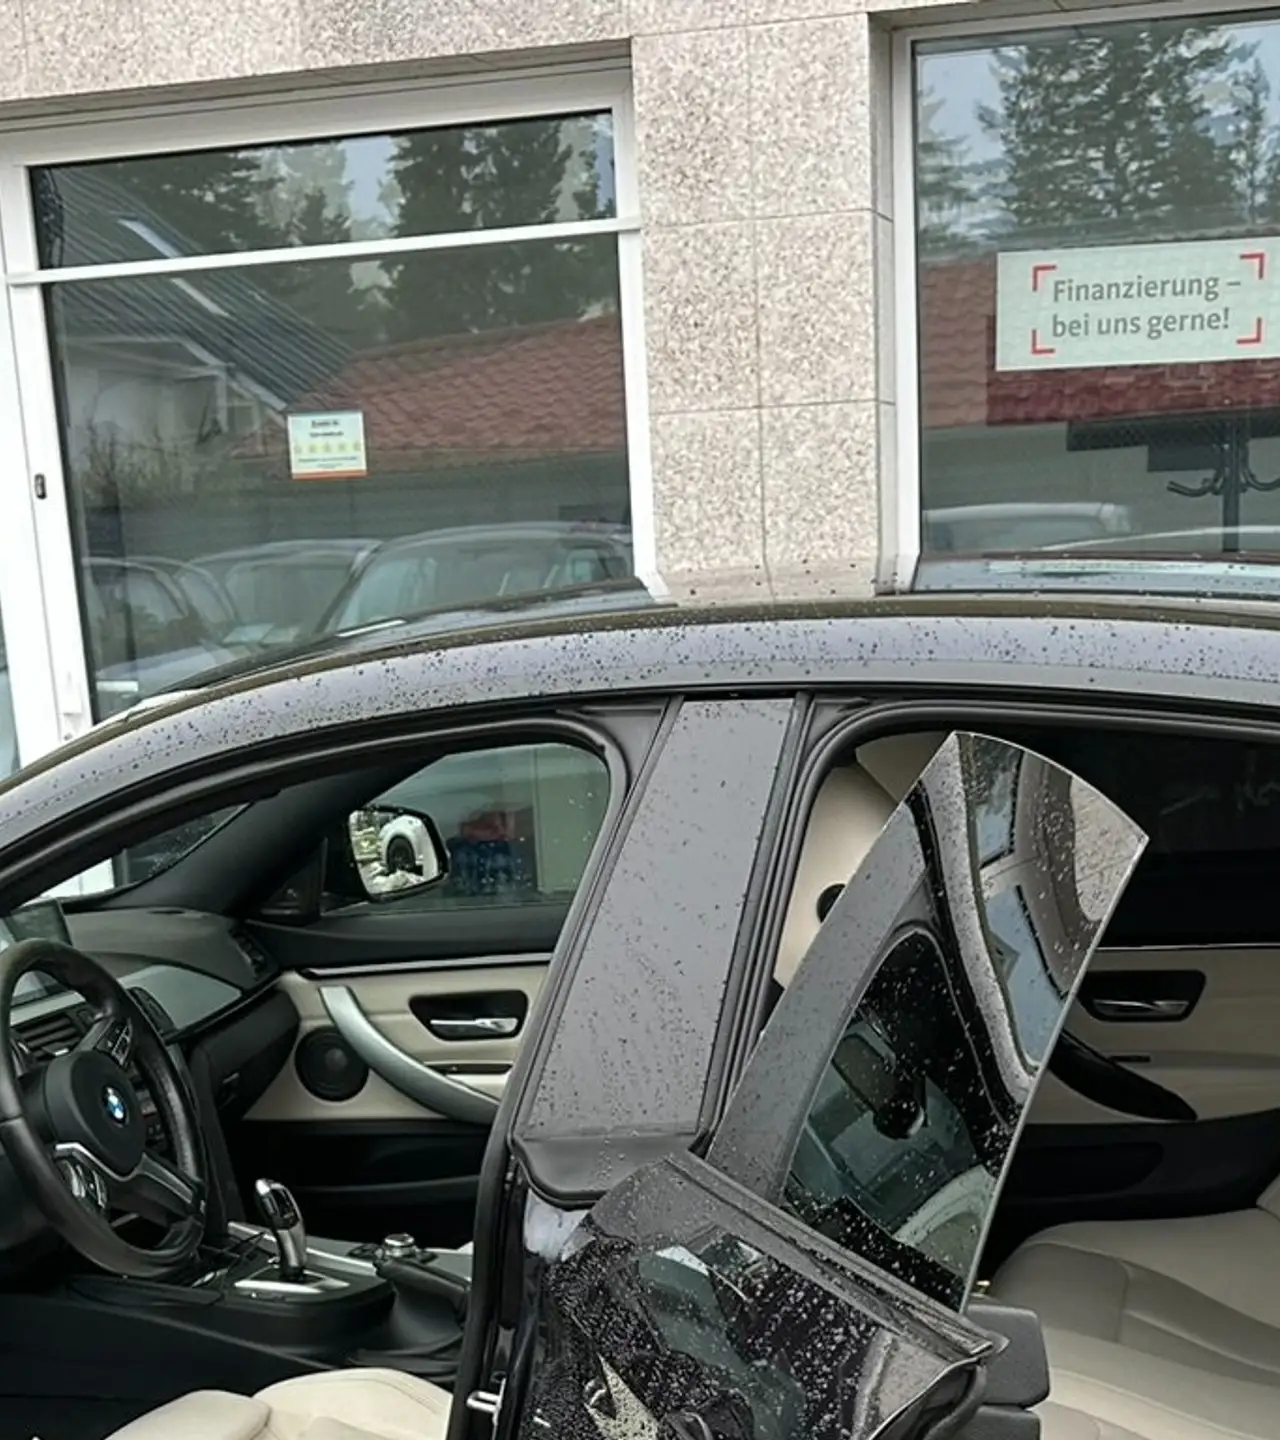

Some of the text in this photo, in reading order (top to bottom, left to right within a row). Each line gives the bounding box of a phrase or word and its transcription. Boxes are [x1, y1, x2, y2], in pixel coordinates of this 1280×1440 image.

[1053, 275, 1220, 302] Finanzierung
[1052, 306, 1230, 341] bei uns gerne!
